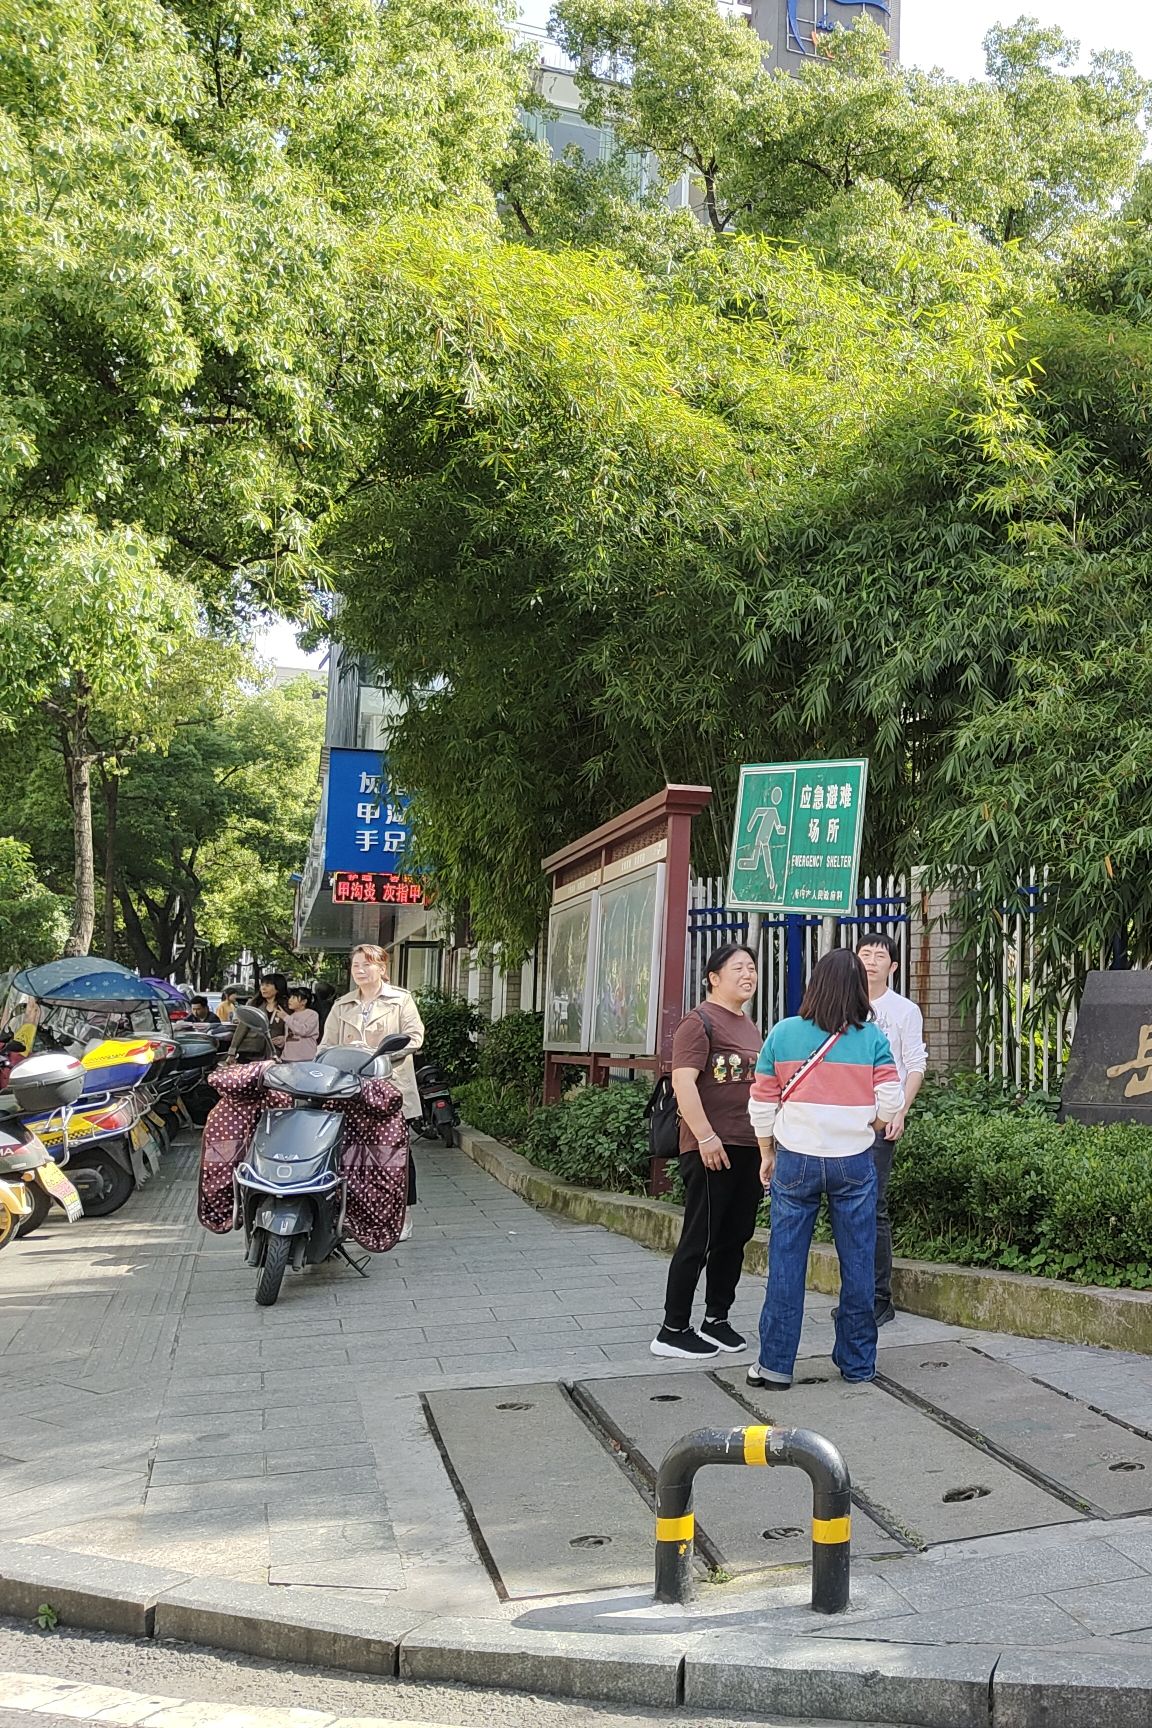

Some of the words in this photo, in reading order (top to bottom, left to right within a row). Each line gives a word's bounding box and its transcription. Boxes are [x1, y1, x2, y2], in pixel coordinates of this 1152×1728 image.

[800, 783, 852, 809] 应急避难
[354, 830, 418, 852] 手足
[808, 818, 840, 843] 场所
[792, 855, 823, 868] EMERGENCY
[826, 855, 851, 868] SHELTER
[338, 881, 376, 901] 甲沟炎
[382, 882, 421, 902] 灰指甲
